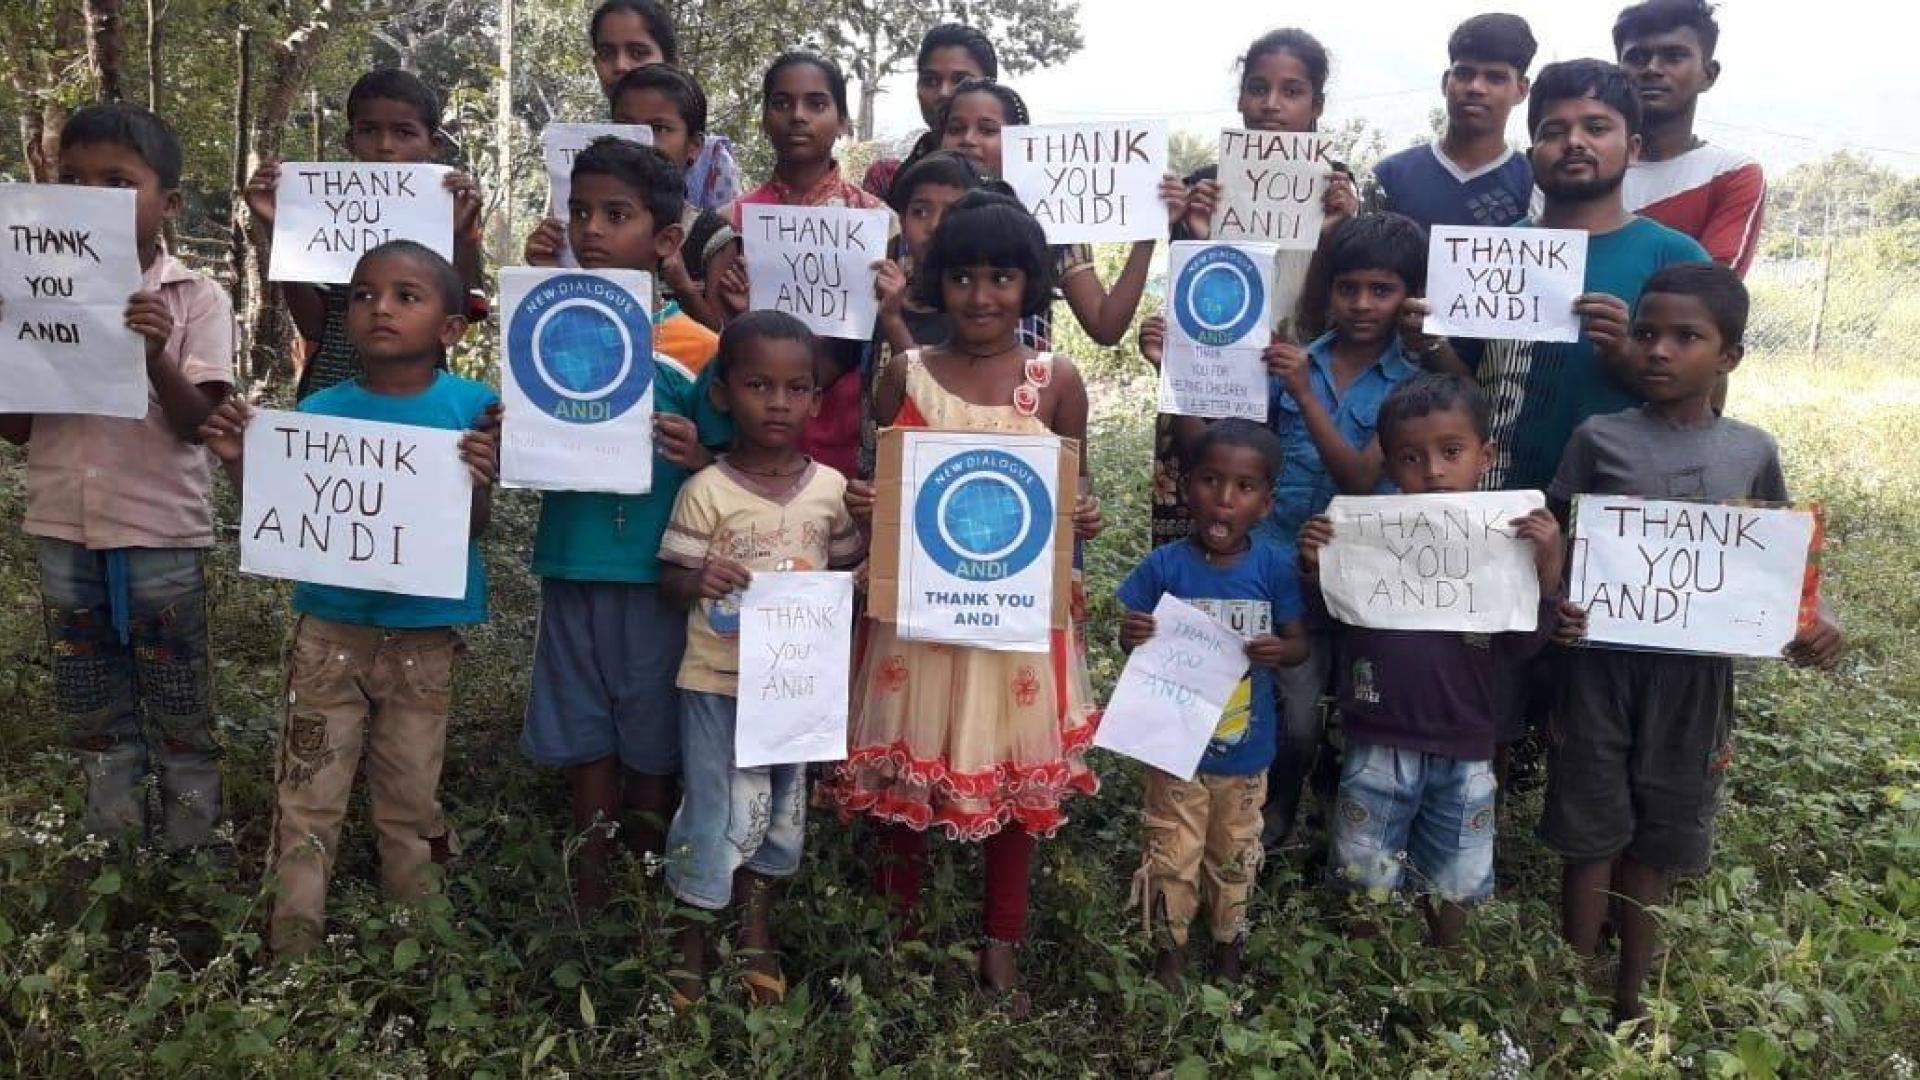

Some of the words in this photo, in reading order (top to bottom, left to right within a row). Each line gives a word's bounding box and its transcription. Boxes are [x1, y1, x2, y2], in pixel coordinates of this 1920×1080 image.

[1019, 129, 1150, 164] THANK
[1223, 131, 1333, 166] THANK
[299, 170, 416, 197] THANK
[1044, 167, 1115, 196] YOU
[1246, 169, 1314, 203] YOU
[325, 199, 380, 224] YOU
[1032, 195, 1128, 226] ANDI
[1218, 206, 1300, 239] ANDI
[9, 224, 101, 263] THANK
[758, 215, 866, 251] THANK
[783, 252, 841, 288] YOU
[1445, 237, 1568, 270] THANK
[25, 276, 73, 298] YOU
[1466, 267, 1525, 295] YOU
[525, 289, 555, 315] NEW
[558, 282, 635, 314] DIALOGUE
[775, 283, 848, 321] ANDI
[1449, 293, 1540, 323] ANDI
[17, 321, 80, 344] ANDI
[554, 400, 611, 421] ANDI
[274, 427, 417, 475] THANK
[934, 461, 963, 485] NEW
[967, 454, 1035, 485] DIALOGUE
[305, 472, 383, 516] YOU
[253, 507, 406, 565] ANDI
[1346, 510, 1513, 541] THANK
[1604, 505, 1765, 550] THANK
[955, 561, 1009, 578] ANDI
[1386, 544, 1470, 579] YOU
[1638, 544, 1725, 593] YOU
[925, 591, 989, 606] THANK
[995, 593, 1035, 608] YOU
[1368, 576, 1476, 613] ANDI
[1586, 582, 1692, 628] ANDI
[757, 605, 833, 631] THANK
[954, 613, 1000, 626] ANDI
[766, 641, 810, 670] YOU
